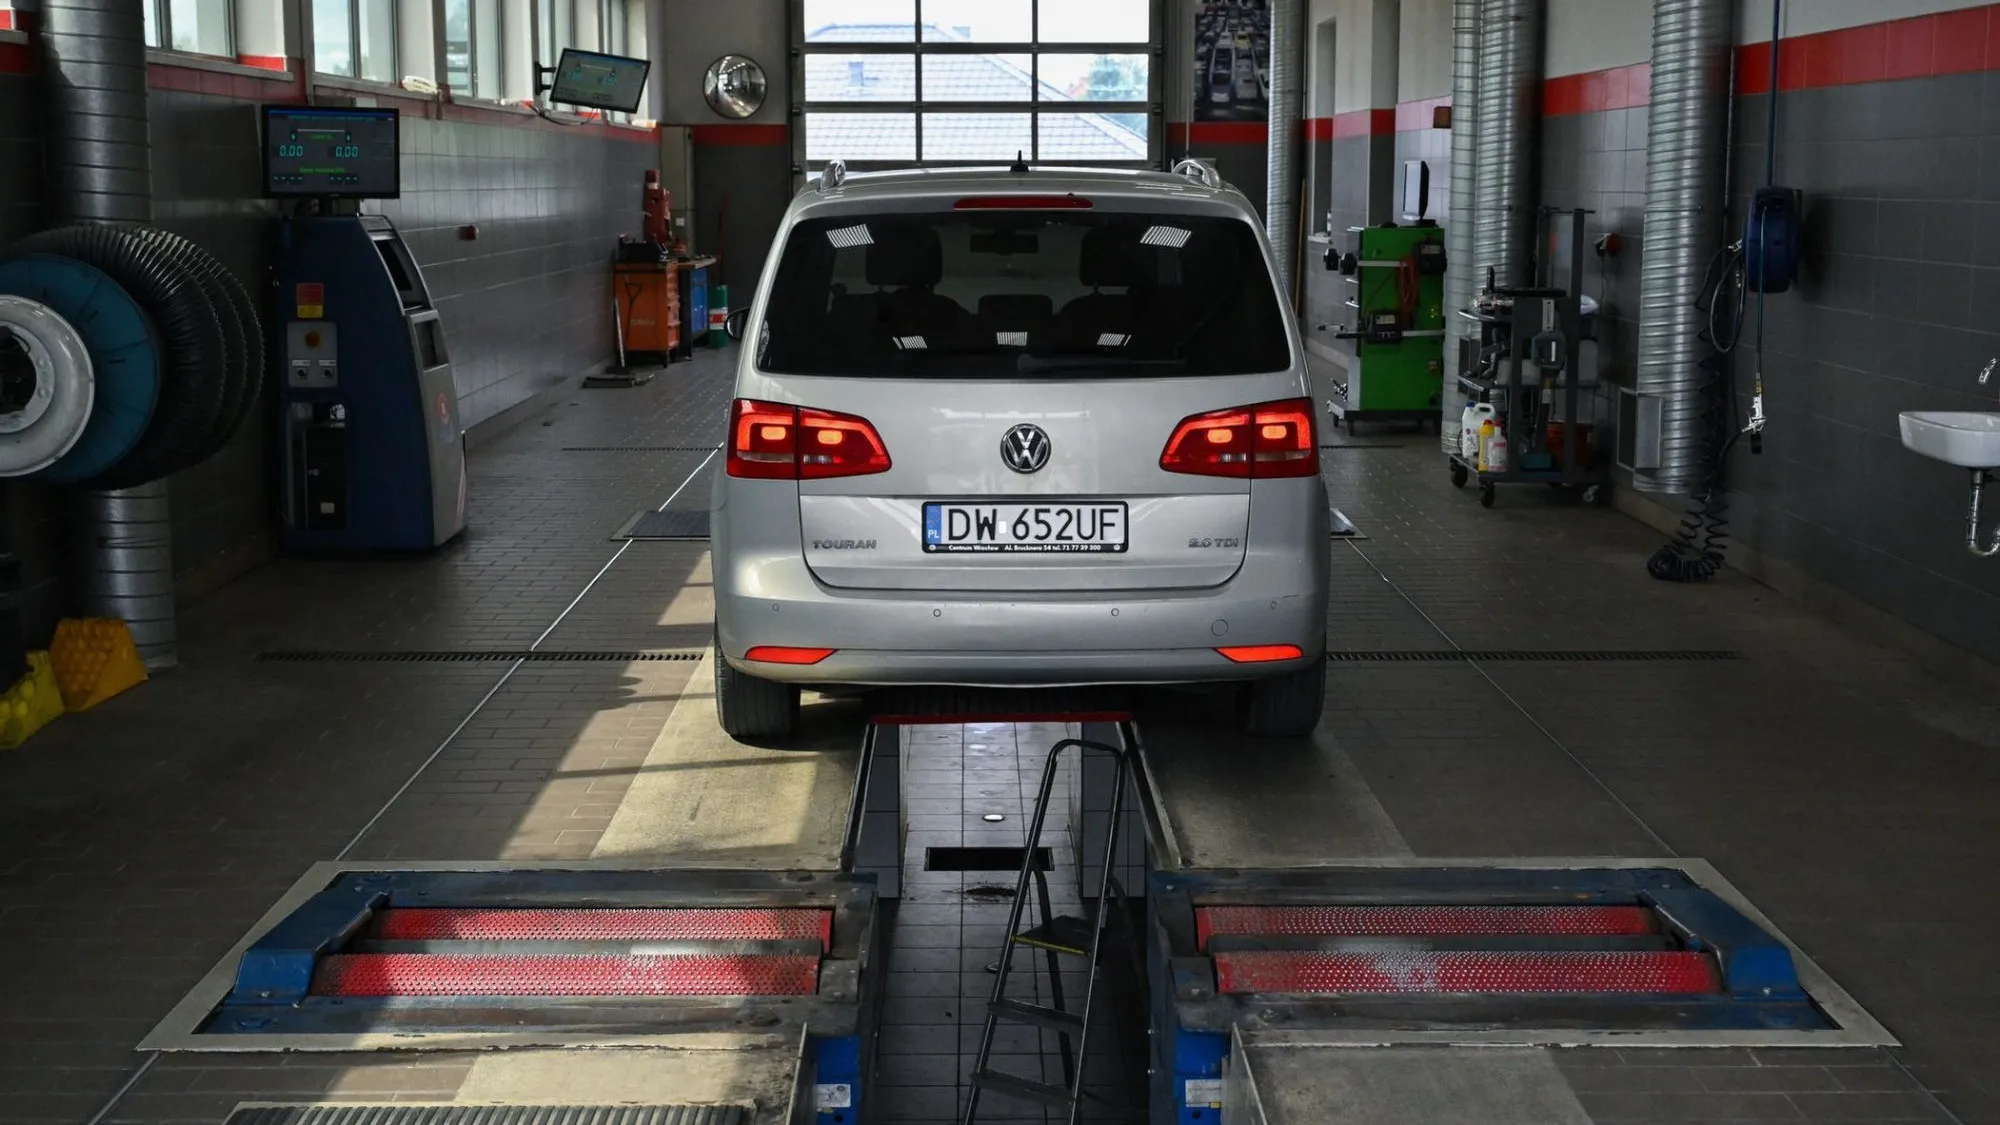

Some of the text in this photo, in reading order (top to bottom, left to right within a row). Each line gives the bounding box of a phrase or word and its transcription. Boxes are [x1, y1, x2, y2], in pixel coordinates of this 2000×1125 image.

[279, 145, 304, 157] 0.00
[335, 146, 359, 158] 0.00
[1000, 423, 1051, 474] VW
[948, 508, 1119, 541] DW 652UF
[928, 529, 940, 539] PL
[812, 539, 877, 549] TOURAN
[1214, 538, 1239, 548] TDI
